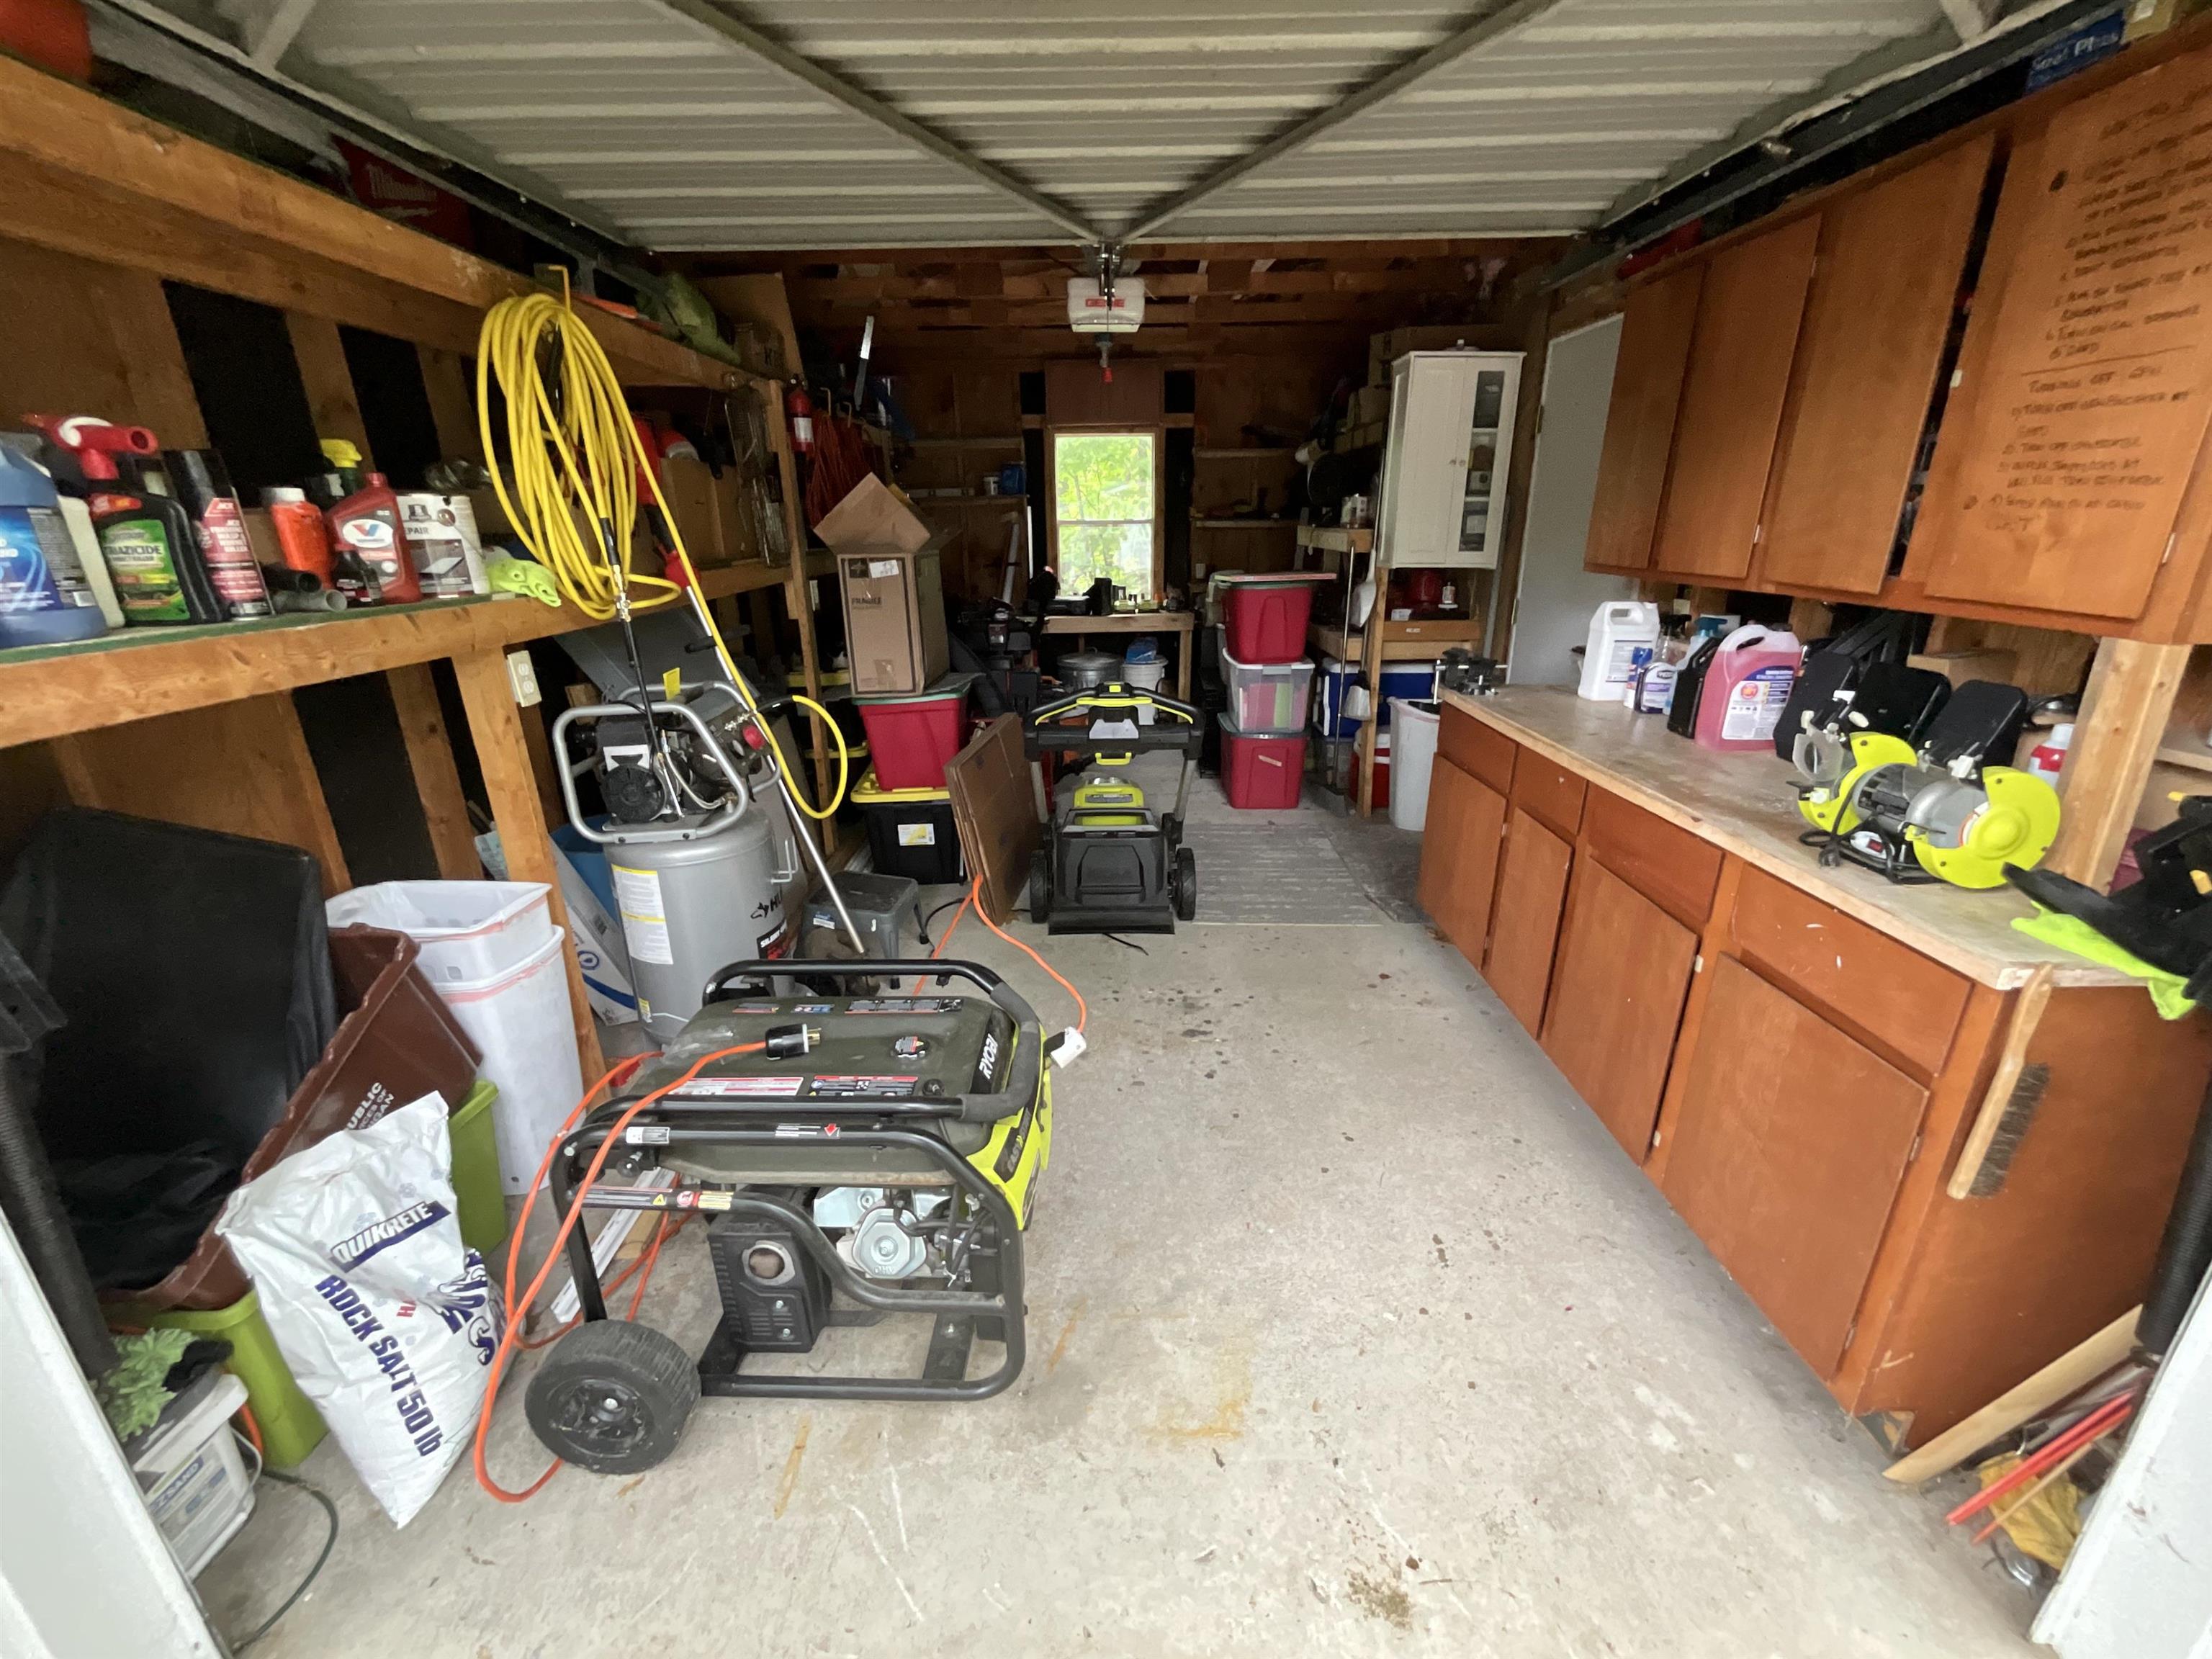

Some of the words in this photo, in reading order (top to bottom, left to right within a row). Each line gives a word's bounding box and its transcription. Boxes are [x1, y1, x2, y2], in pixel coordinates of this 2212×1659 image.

[979, 1033, 999, 1080] RYOBI
[347, 1082, 382, 1130] UBLIC
[331, 1200, 436, 1265] QUIKRETE
[315, 1274, 385, 1342] ROCK
[369, 1335, 418, 1393] SALT
[396, 1389, 435, 1437] 50
[413, 1427, 446, 1457] lb
